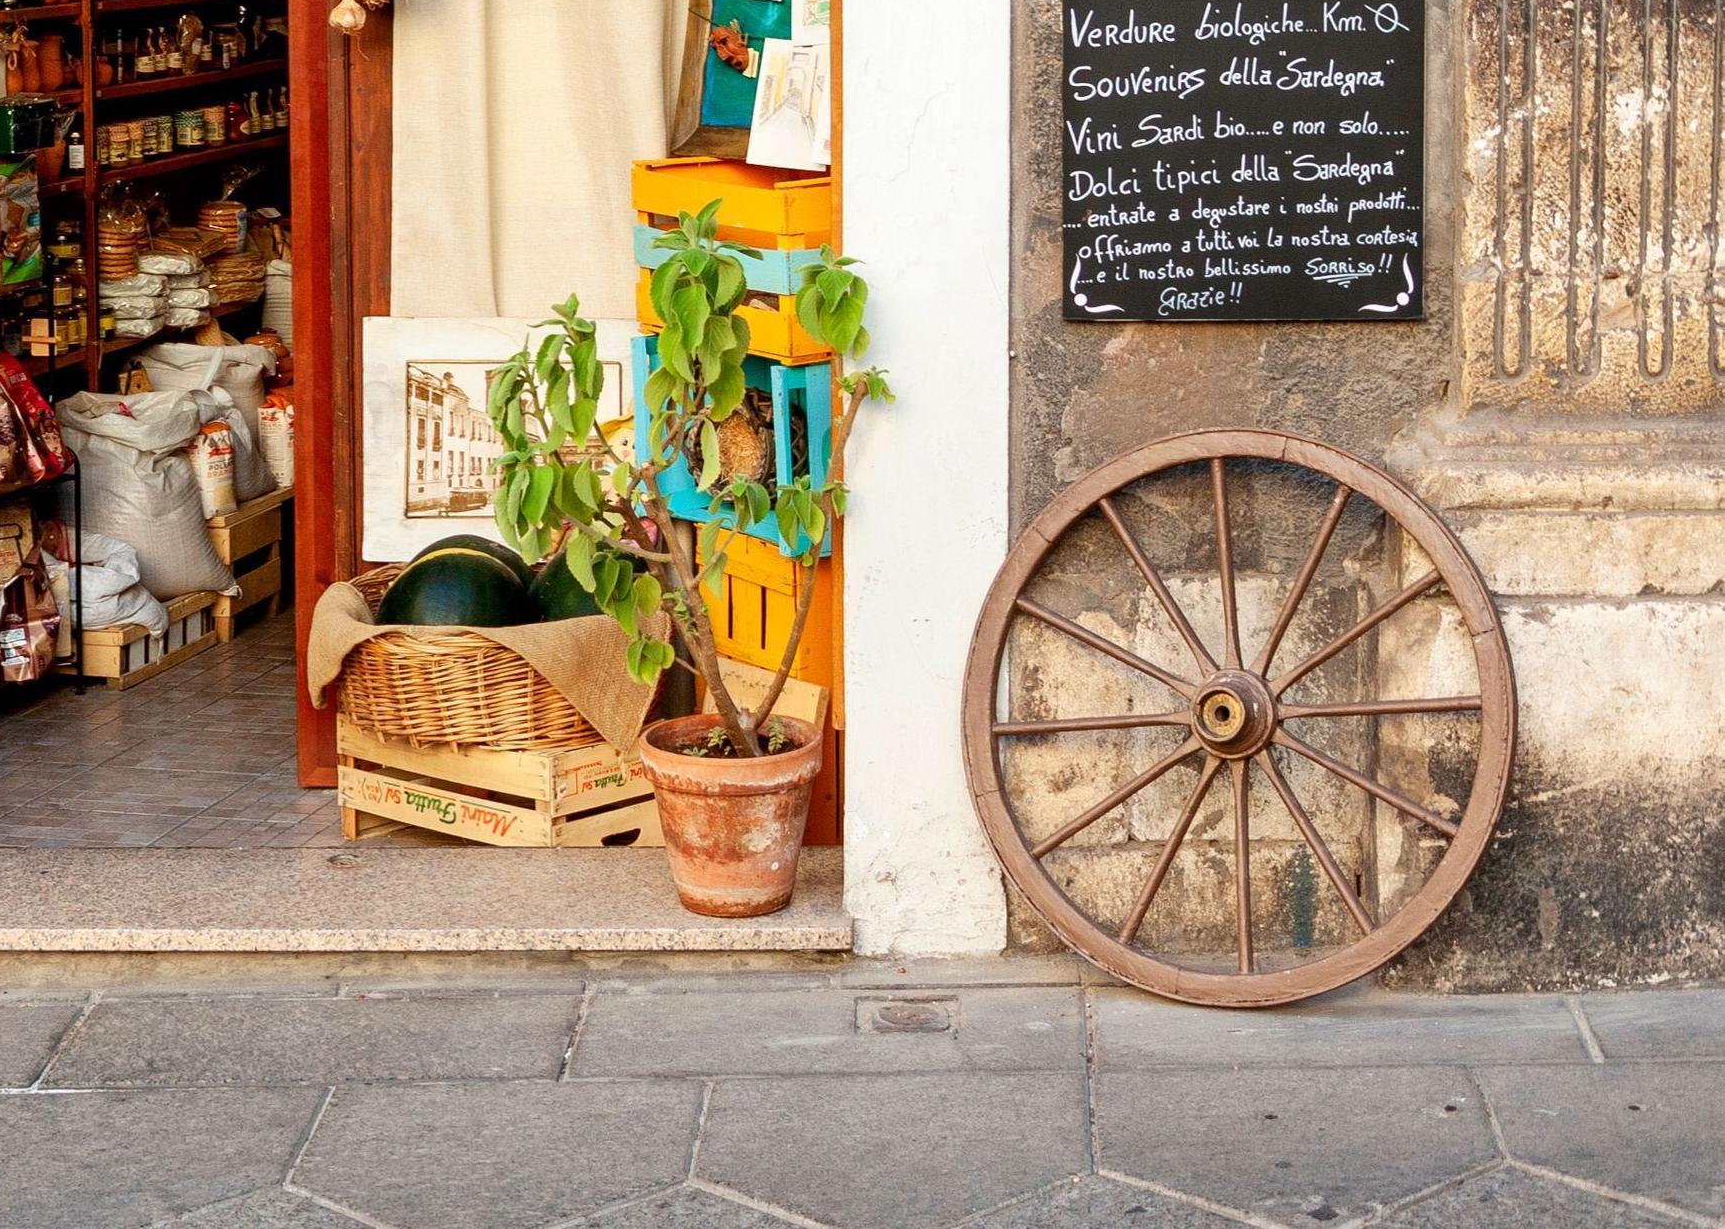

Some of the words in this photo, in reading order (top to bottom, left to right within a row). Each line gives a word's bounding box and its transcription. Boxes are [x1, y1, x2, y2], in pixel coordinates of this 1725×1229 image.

[1070, 7, 1176, 48] Verdure
[1069, 64, 1206, 101] Souvenirs
[1219, 57, 1272, 86] della
[1066, 116, 1121, 155] Vini
[1131, 113, 1204, 148] Sardi
[1293, 120, 1326, 135] non
[1068, 167, 1142, 201] Dolci
[1155, 159, 1221, 194] tipici
[1232, 153, 1280, 183] della
[1169, 207, 1179, 221] a
[1192, 195, 1269, 228] degustare
[1279, 197, 1287, 214] i
[1296, 193, 1338, 214] nostri
[1078, 234, 1171, 264] offriamo
[1181, 239, 1191, 252] a
[1195, 229, 1235, 252] tutti
[1238, 233, 1260, 248] voi
[1267, 227, 1283, 248] la
[1291, 229, 1350, 246] nostra
[1115, 265, 1130, 281] il
[1139, 259, 1194, 279] nostro
[1204, 257, 1292, 277] bellissimo
[404, 791, 457, 825] Frutta
[459, 804, 518, 837] Maini
